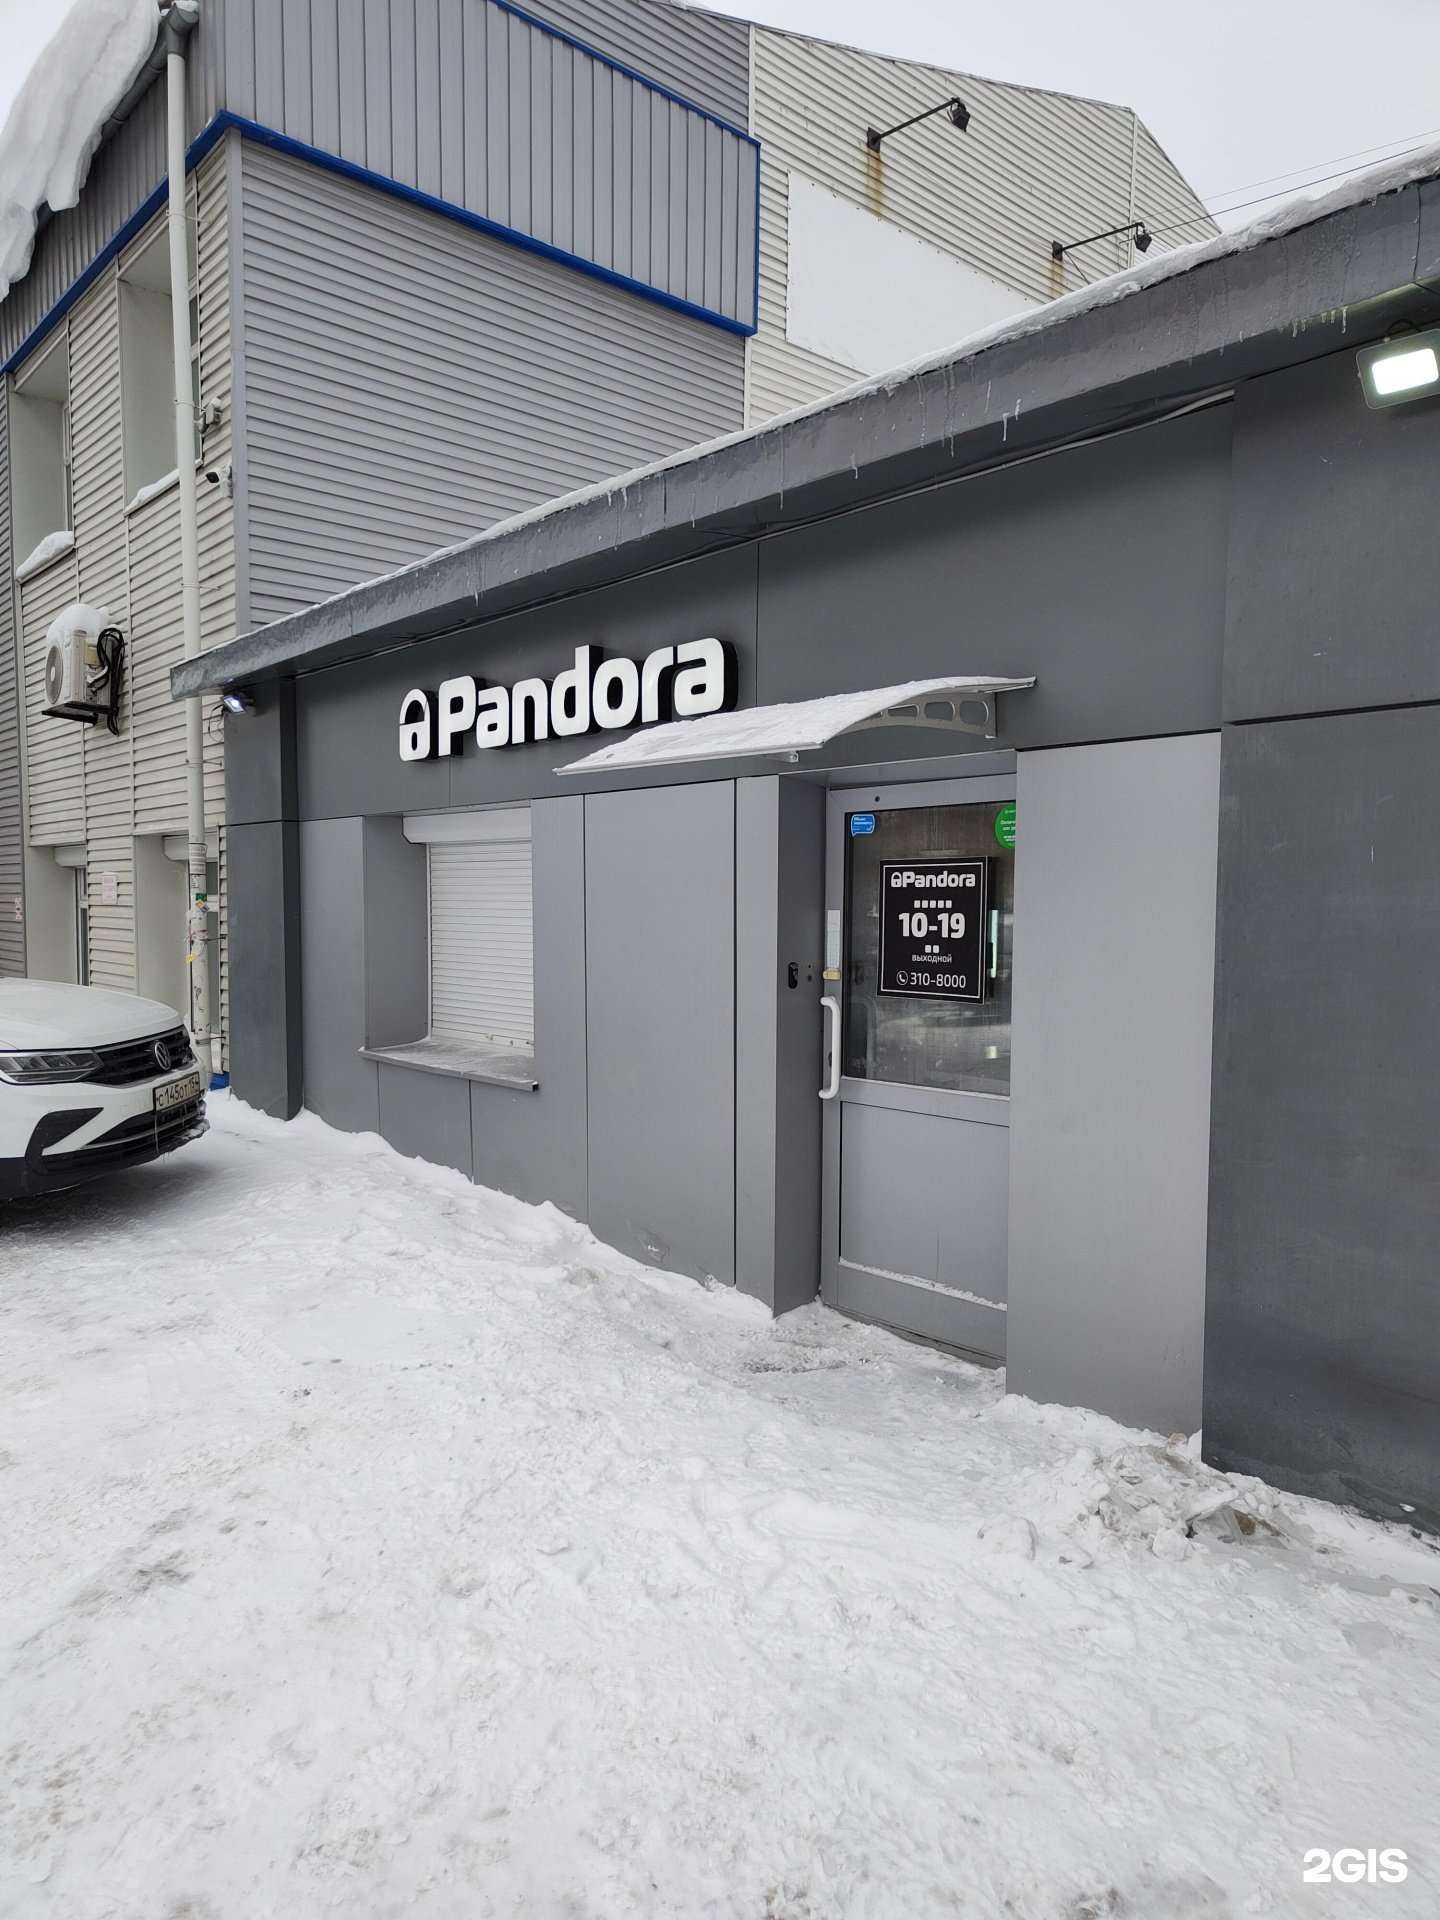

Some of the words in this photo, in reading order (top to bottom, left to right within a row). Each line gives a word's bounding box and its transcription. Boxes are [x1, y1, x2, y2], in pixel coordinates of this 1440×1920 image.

[437, 637, 726, 758] Pandora
[902, 870, 976, 888] Pandora
[898, 912, 966, 939] 10-19
[911, 953, 953, 964] выходной
[910, 972, 967, 989] 310-8000
